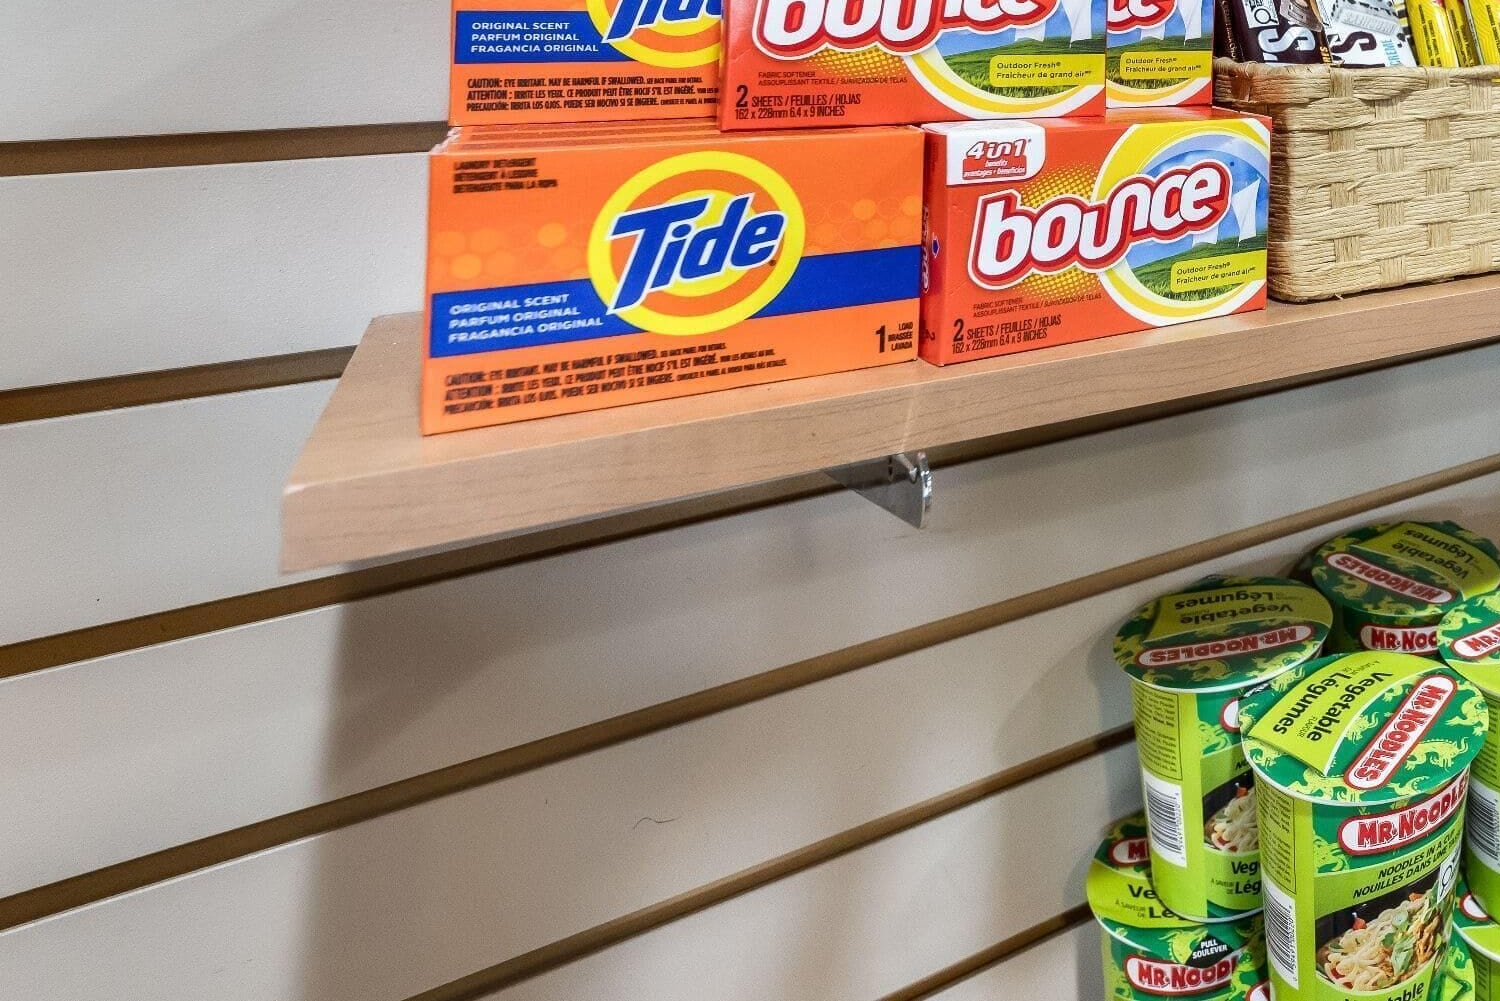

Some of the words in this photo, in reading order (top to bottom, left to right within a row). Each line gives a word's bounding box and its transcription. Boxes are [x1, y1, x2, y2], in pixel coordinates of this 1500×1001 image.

[471, 33, 521, 42] PARFUM
[523, 33, 580, 42] ORIGINAL
[472, 22, 530, 31] ORIGINAL
[532, 22, 570, 30] SCENT
[470, 44, 541, 54] FRAGANCIA
[544, 44, 599, 53] ORIGINAL
[1038, 70, 1048, 78] de
[1050, 70, 1073, 79] grand
[736, 85, 748, 108] 2
[752, 95, 784, 108] SHEETS
[791, 94, 828, 106] FEUILLES
[835, 94, 861, 105] HOJAS
[736, 108, 749, 120] 162
[810, 106, 815, 118] 9
[816, 106, 846, 117] INCHES
[967, 160, 1232, 291] bounce
[606, 193, 785, 316] Tide
[1176, 265, 1206, 276] Outdoor
[1210, 274, 1218, 282] de
[1220, 270, 1240, 282] grand
[450, 300, 521, 315] ORIGINAL
[524, 292, 570, 308] SCENT
[448, 313, 510, 330] PARFUM
[514, 306, 580, 322] ORIGINAL
[898, 322, 913, 332] LOAD
[953, 318, 964, 342] 2
[967, 323, 994, 340] SHEETS
[1000, 318, 1032, 336] FEUILLES
[1038, 314, 1062, 331] HOJAS
[448, 325, 534, 344] FRAGANCIA
[538, 316, 604, 334] ORIGINAL
[875, 325, 886, 353] 1
[890, 340, 913, 352] LAVADA
[1405, 530, 1476, 564] Légumes
[1392, 542, 1468, 579] Vegetable
[1175, 591, 1274, 610] Légumes
[1180, 603, 1294, 625] Vegetable
[1371, 628, 1437, 650] MR.NOO
[1272, 672, 1350, 735] Légumes
[1307, 672, 1394, 743] Vegetable
[1358, 771, 1468, 847] MR.NOODLE
[1378, 855, 1424, 880] NOODLES
[1426, 848, 1435, 858] IN
[1353, 872, 1404, 899] NOUILLES
[1406, 859, 1431, 879] DANS
[1192, 944, 1228, 960] SOULEVER
[1200, 939, 1218, 948] PULL
[1138, 957, 1237, 990] MR.NOOD
